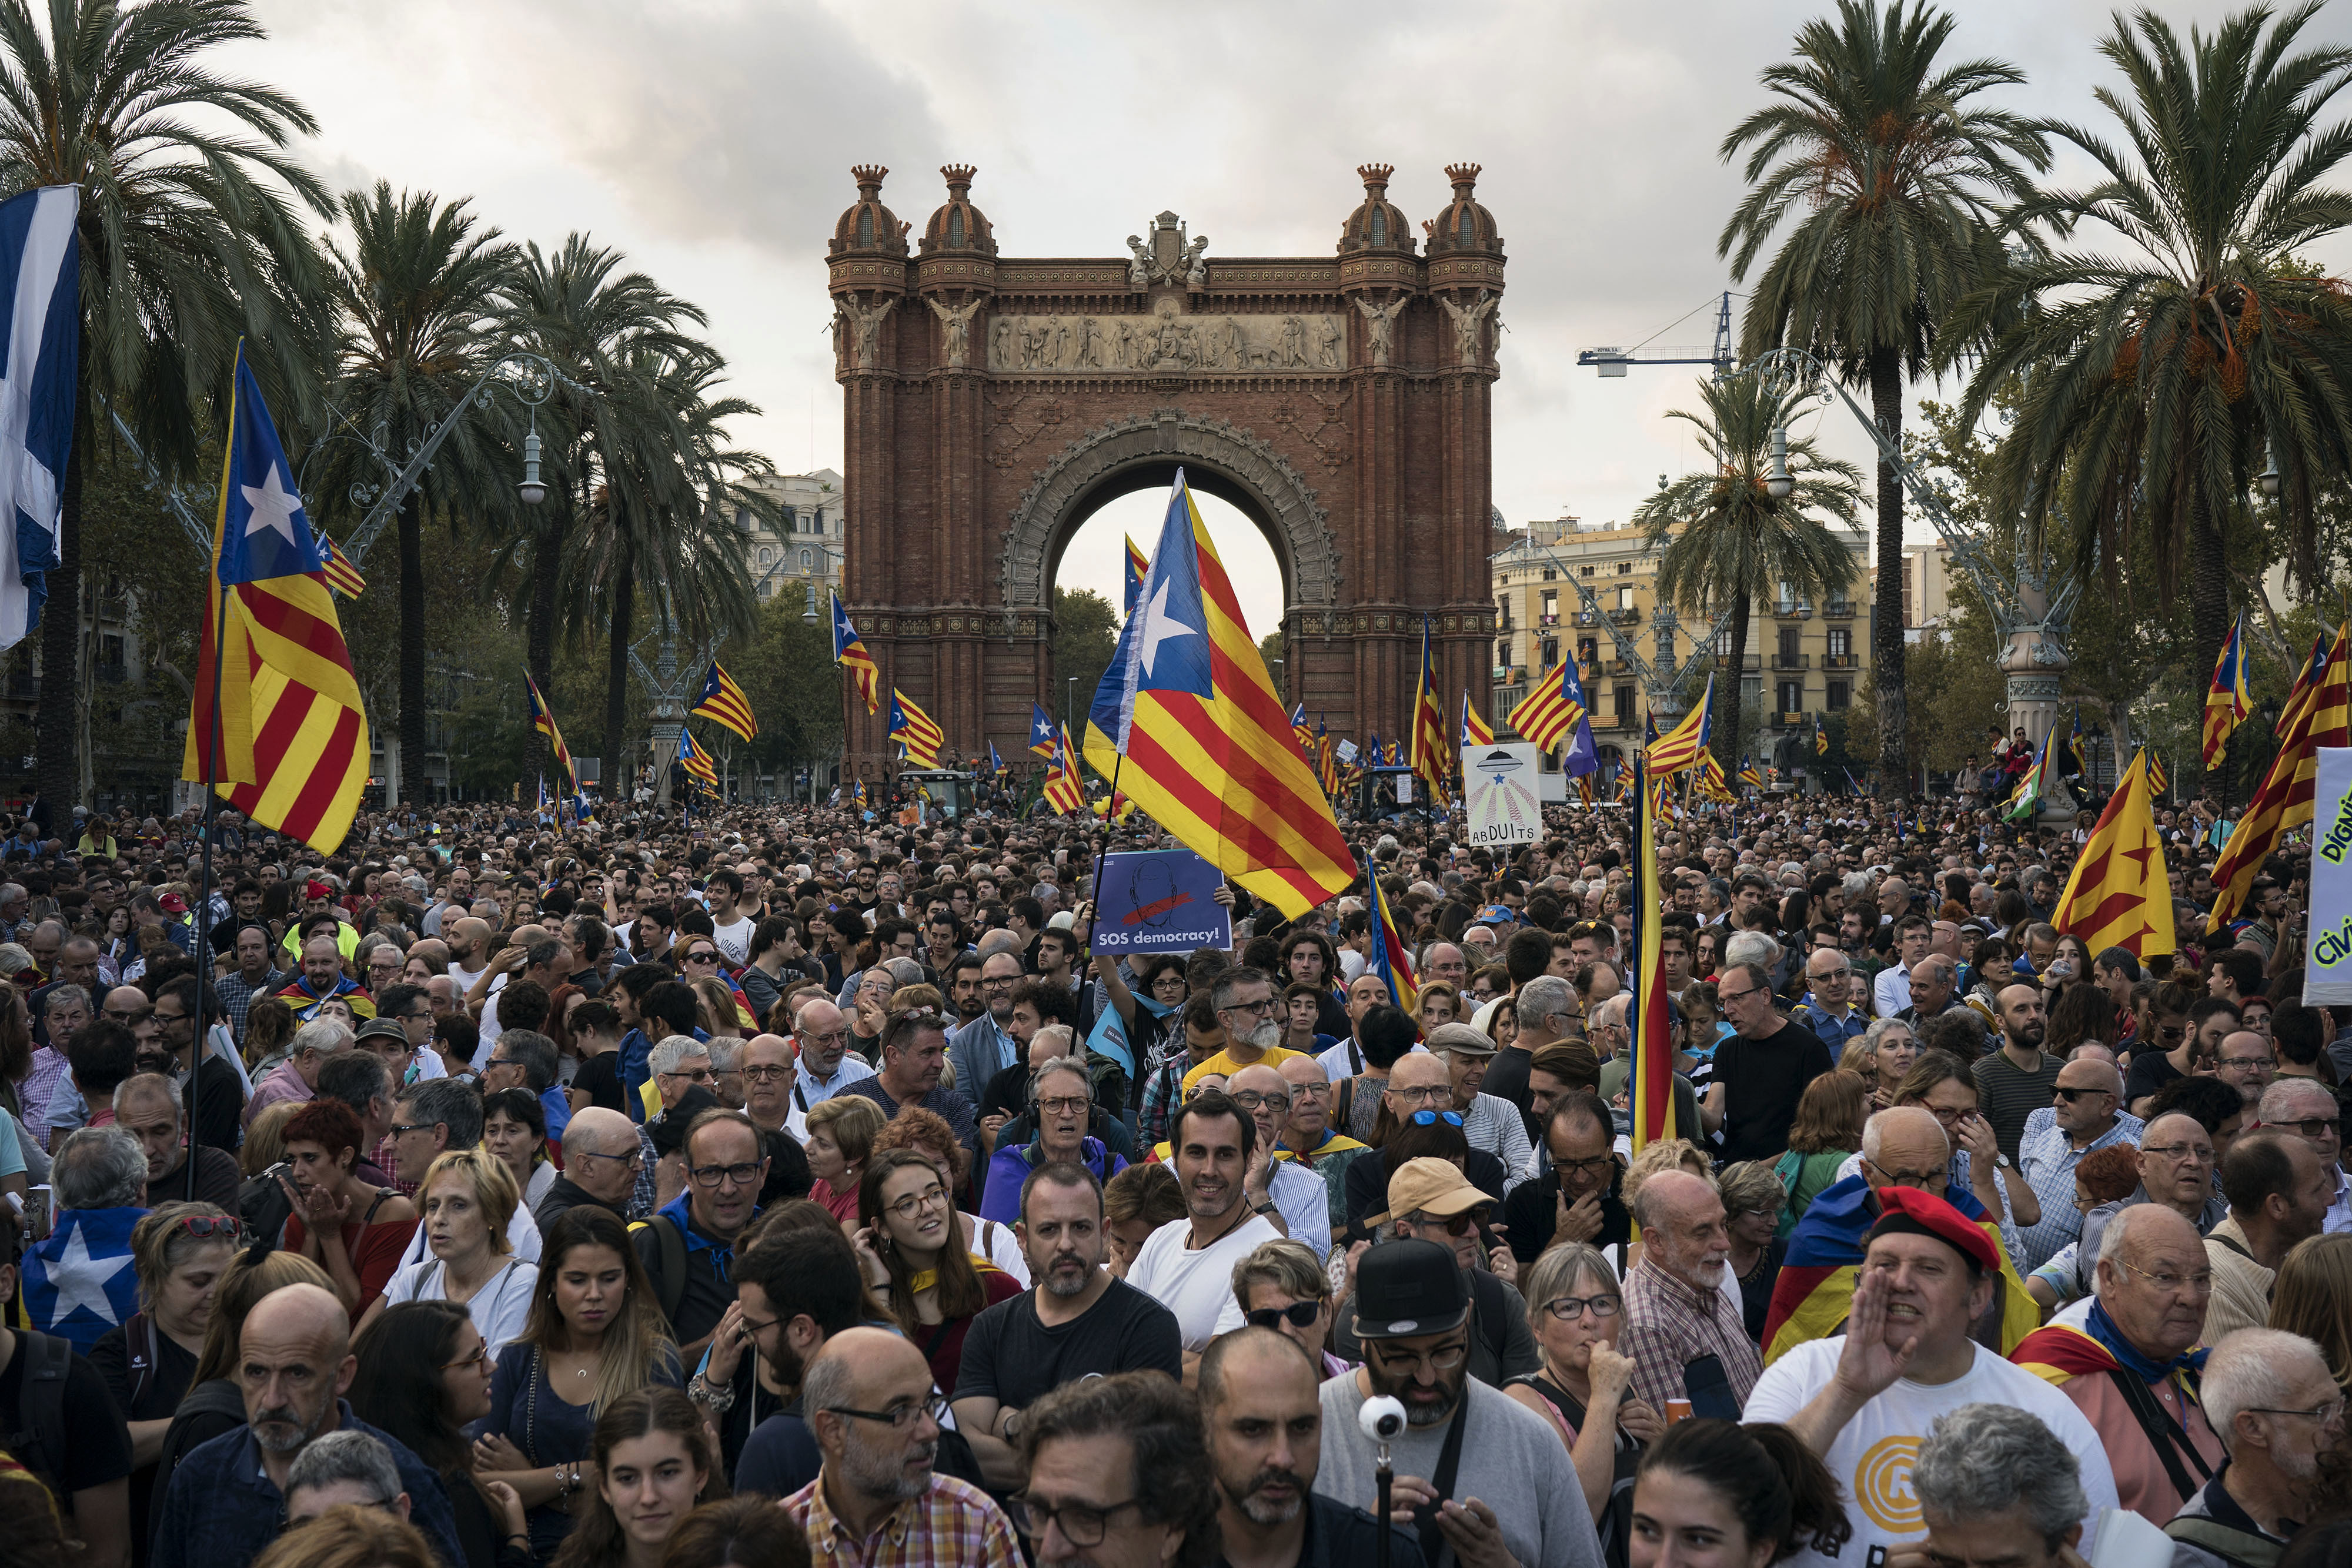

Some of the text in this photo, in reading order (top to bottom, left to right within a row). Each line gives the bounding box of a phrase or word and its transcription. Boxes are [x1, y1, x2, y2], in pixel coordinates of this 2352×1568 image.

[1473, 824, 1534, 842] ABDUITS
[1099, 927, 1219, 945] SOS democracy!
[717, 938, 740, 958] JONES
